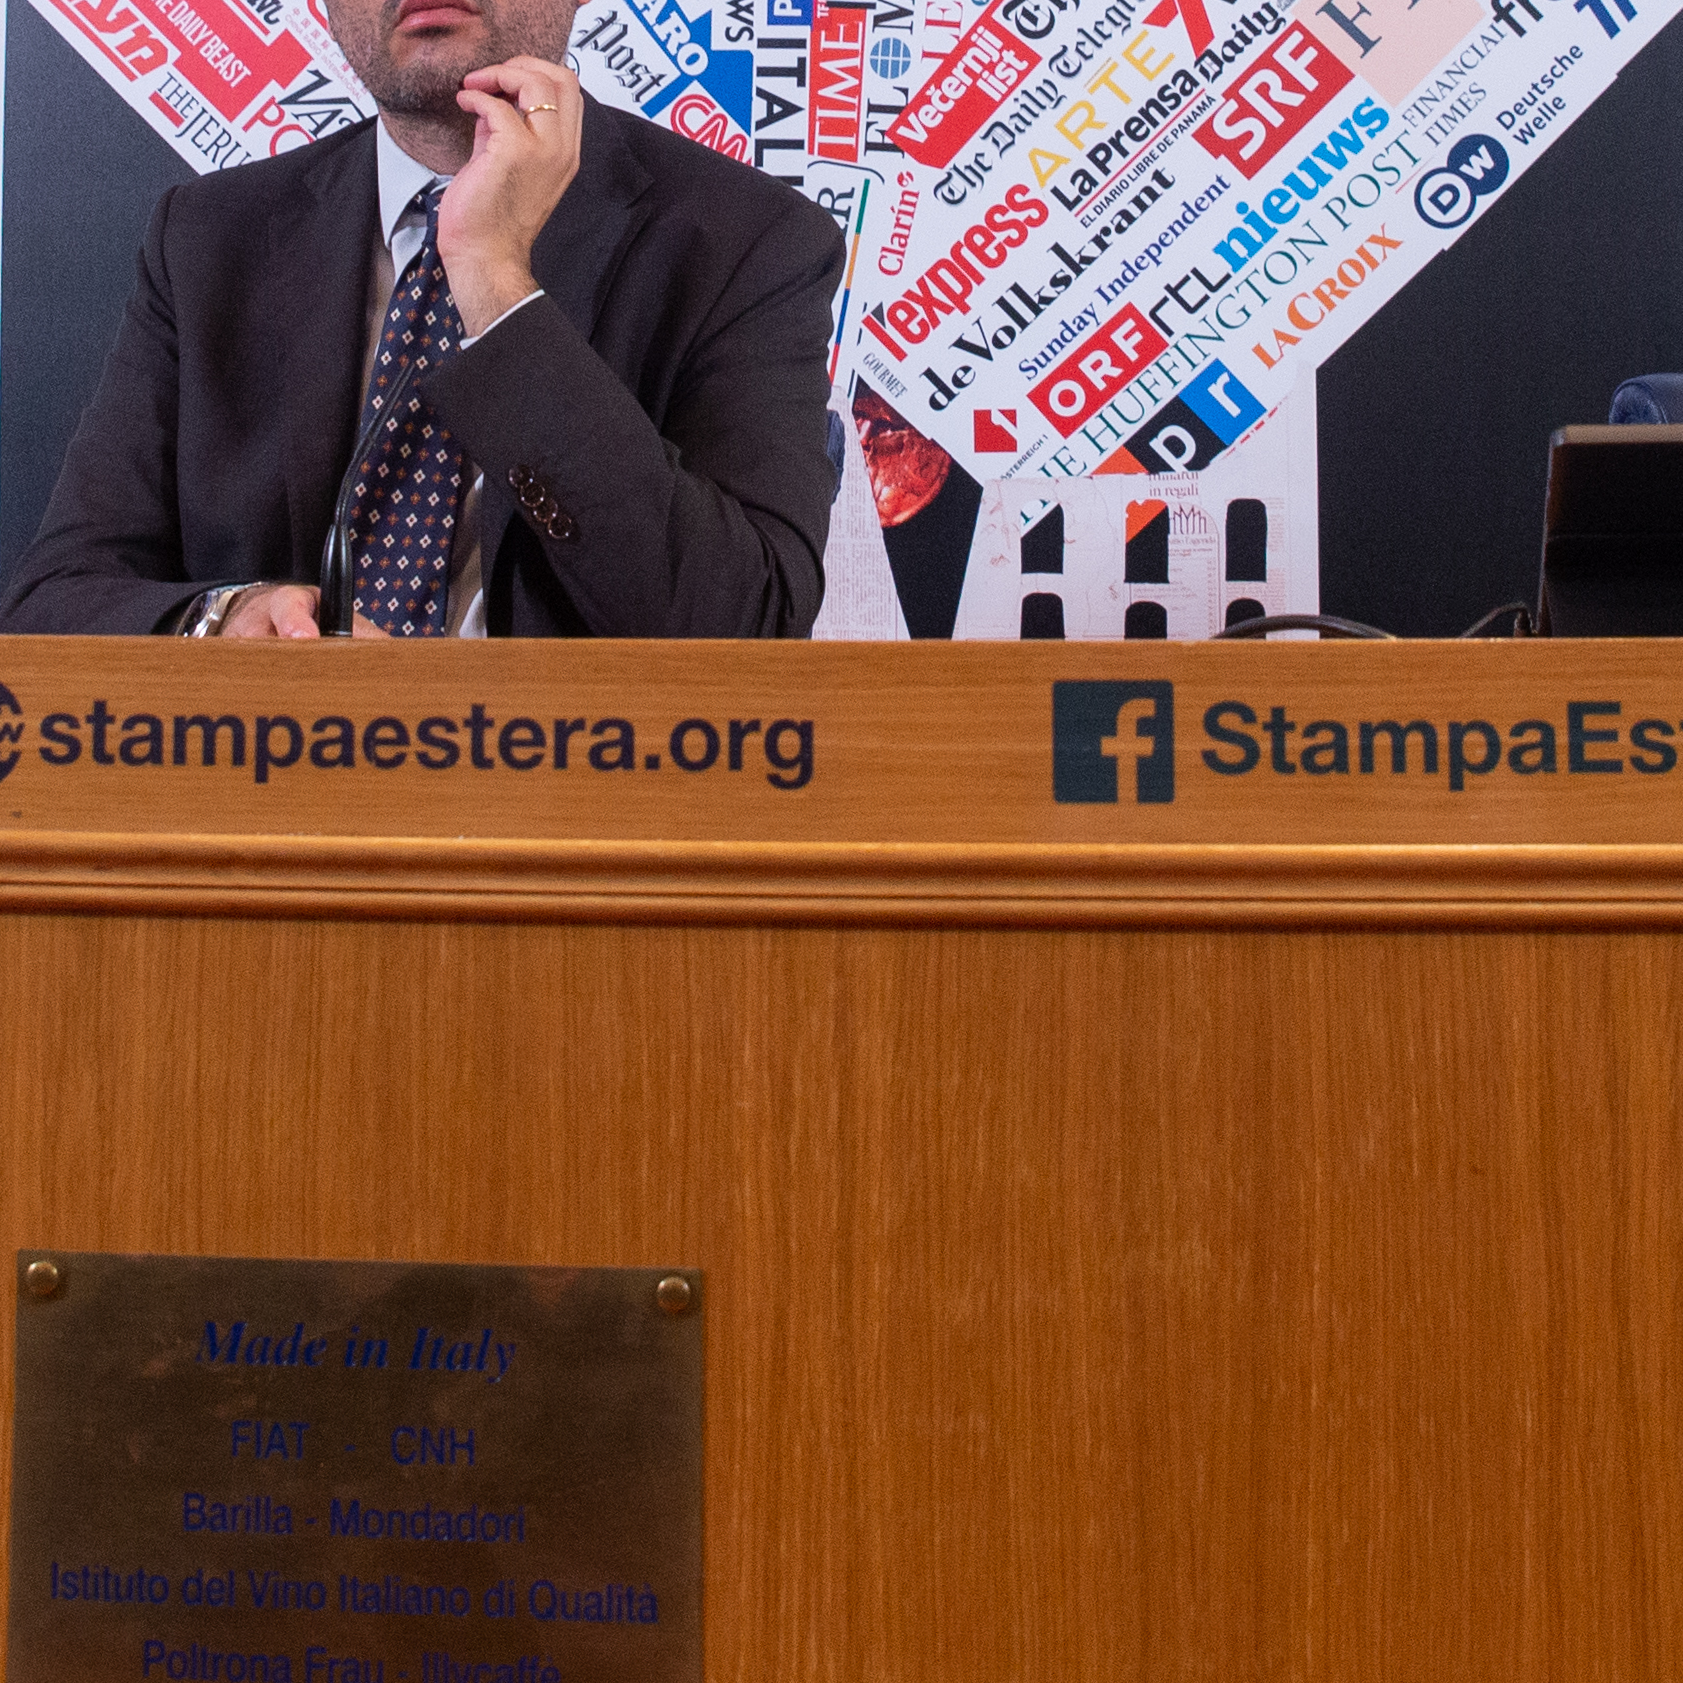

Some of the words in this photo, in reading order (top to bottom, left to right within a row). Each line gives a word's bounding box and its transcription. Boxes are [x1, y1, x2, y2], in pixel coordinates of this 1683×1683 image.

[814, 20, 864, 150] TIME
[898, 26, 1003, 145] Večernji
[976, 47, 1029, 103] list
[1213, 30, 1318, 162] SRF
[1496, 44, 1584, 131] Deutsche
[1512, 94, 1566, 146] Welle
[1212, 96, 1390, 273] nieuws
[948, 166, 1178, 365] Volkskrant
[1018, 286, 1104, 382] Sunday
[1096, 174, 1231, 302] Independent
[920, 360, 977, 413] de
[1048, 321, 1152, 417] ORF
[39, 700, 816, 790] stampaestera.org
[197, 1321, 328, 1366] Made
[344, 1325, 389, 1368] in
[409, 1327, 517, 1384] Italy
[229, 1421, 310, 1459] FIAT
[390, 1425, 476, 1466] CNH
[181, 1493, 294, 1535] Barilla
[329, 1499, 527, 1544] Mondadori
[50, 1562, 170, 1605] Istituto
[181, 1568, 236, 1607] del
[247, 1570, 326, 1611] Vino
[339, 1574, 471, 1617] Italiano
[484, 1579, 516, 1618] di
[527, 1581, 658, 1625] Qualità
[142, 1639, 293, 1683] Poltrona
